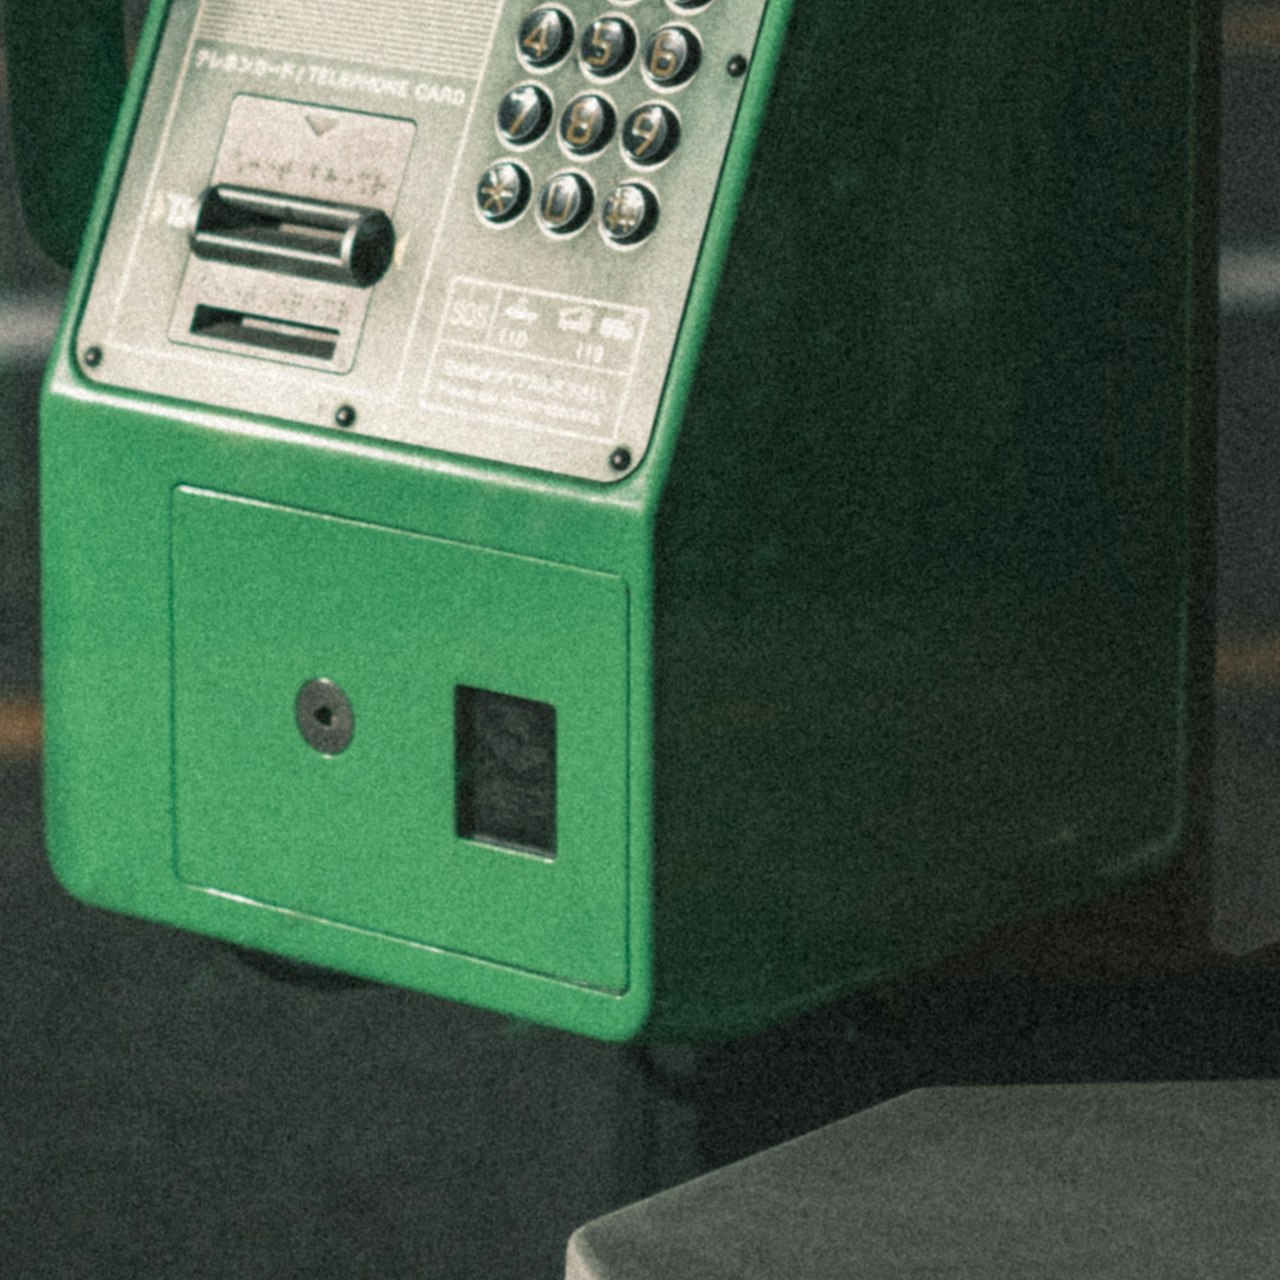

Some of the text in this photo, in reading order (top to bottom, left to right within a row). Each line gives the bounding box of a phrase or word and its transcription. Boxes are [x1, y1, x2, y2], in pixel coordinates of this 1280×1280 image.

[523, 11, 678, 77] 4 5 6
[413, 83, 467, 106] CARD
[508, 91, 661, 157] 7 8 9
[543, 180, 575, 224] 0
[448, 300, 490, 330] SOS
